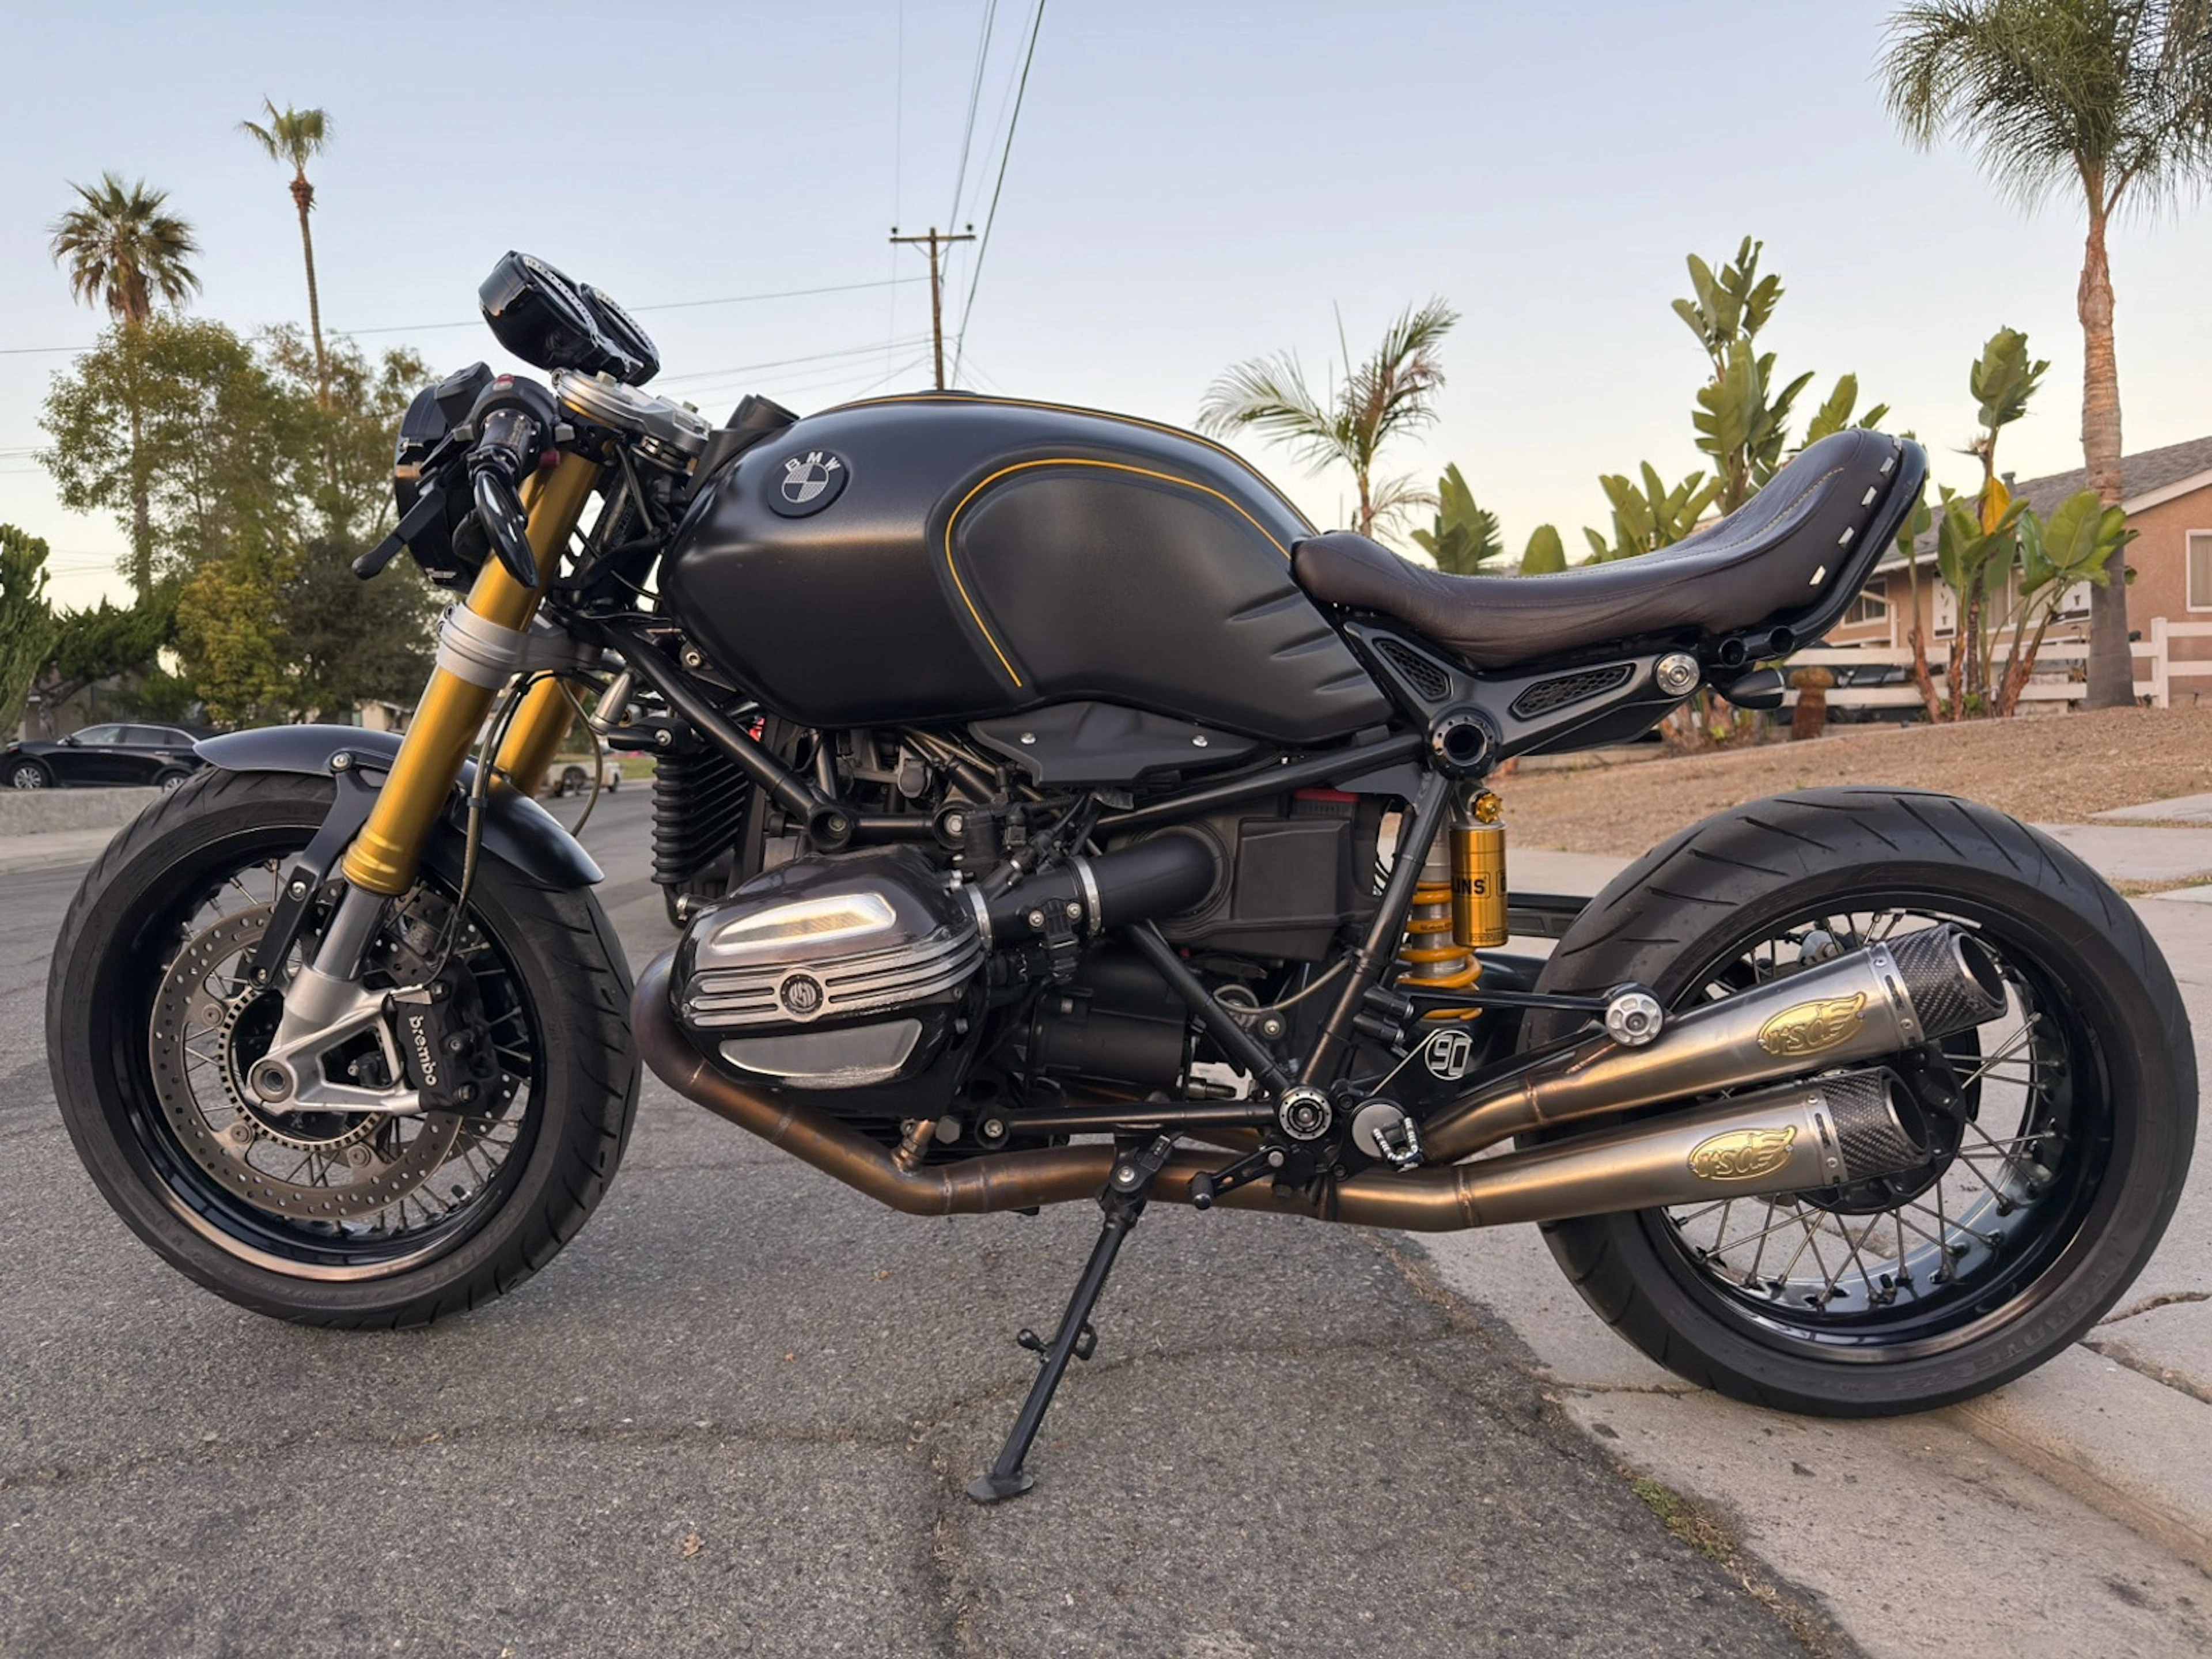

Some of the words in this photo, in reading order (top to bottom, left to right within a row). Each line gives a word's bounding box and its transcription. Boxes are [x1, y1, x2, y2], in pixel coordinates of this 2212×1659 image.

[785, 452, 841, 472] BMW
[409, 1016, 437, 1085] brembo
[1430, 1035, 1471, 1076] 90
